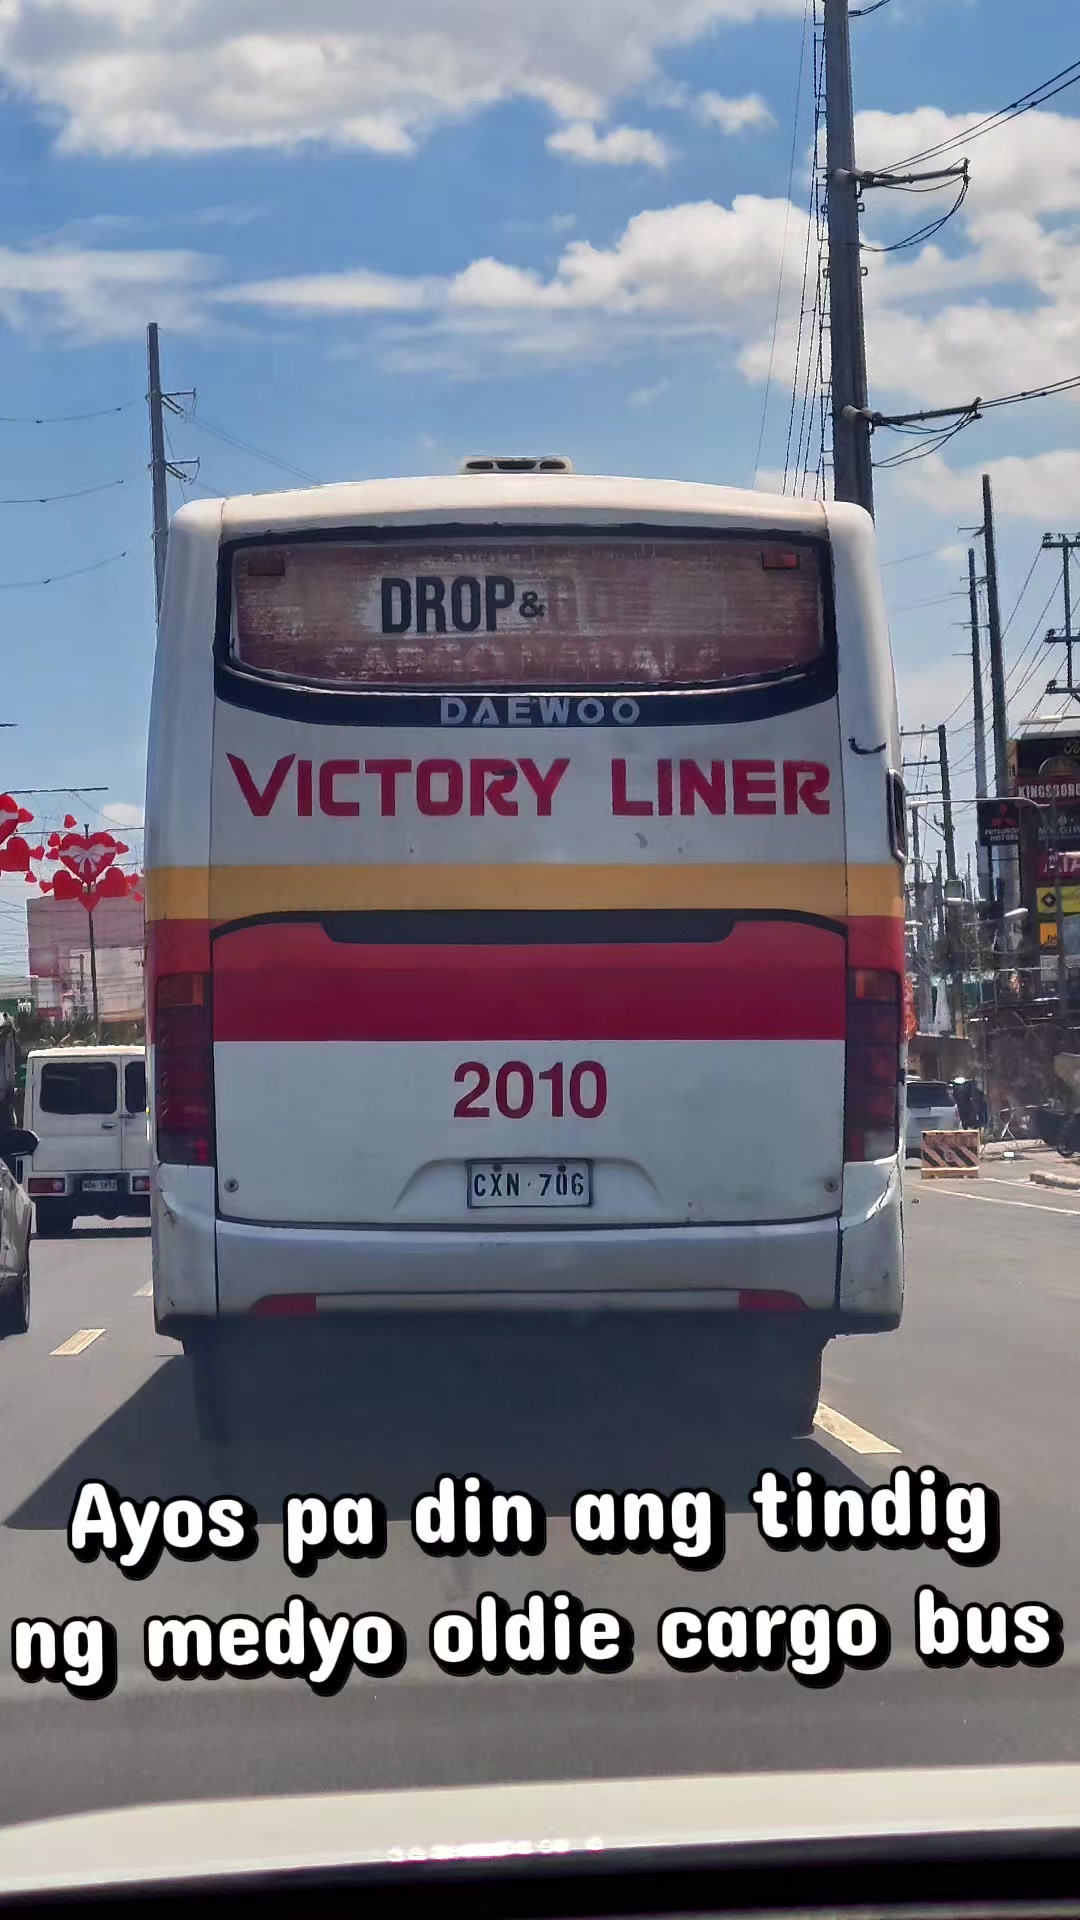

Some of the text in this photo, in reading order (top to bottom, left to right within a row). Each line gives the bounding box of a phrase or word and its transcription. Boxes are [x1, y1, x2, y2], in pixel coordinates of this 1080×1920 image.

[381, 575, 515, 633] DROP
[440, 697, 640, 725] DAEWOO
[226, 752, 830, 817] VICTORY LINER
[454, 1060, 608, 1119] 2010
[473, 1173, 585, 1197] CXN 706
